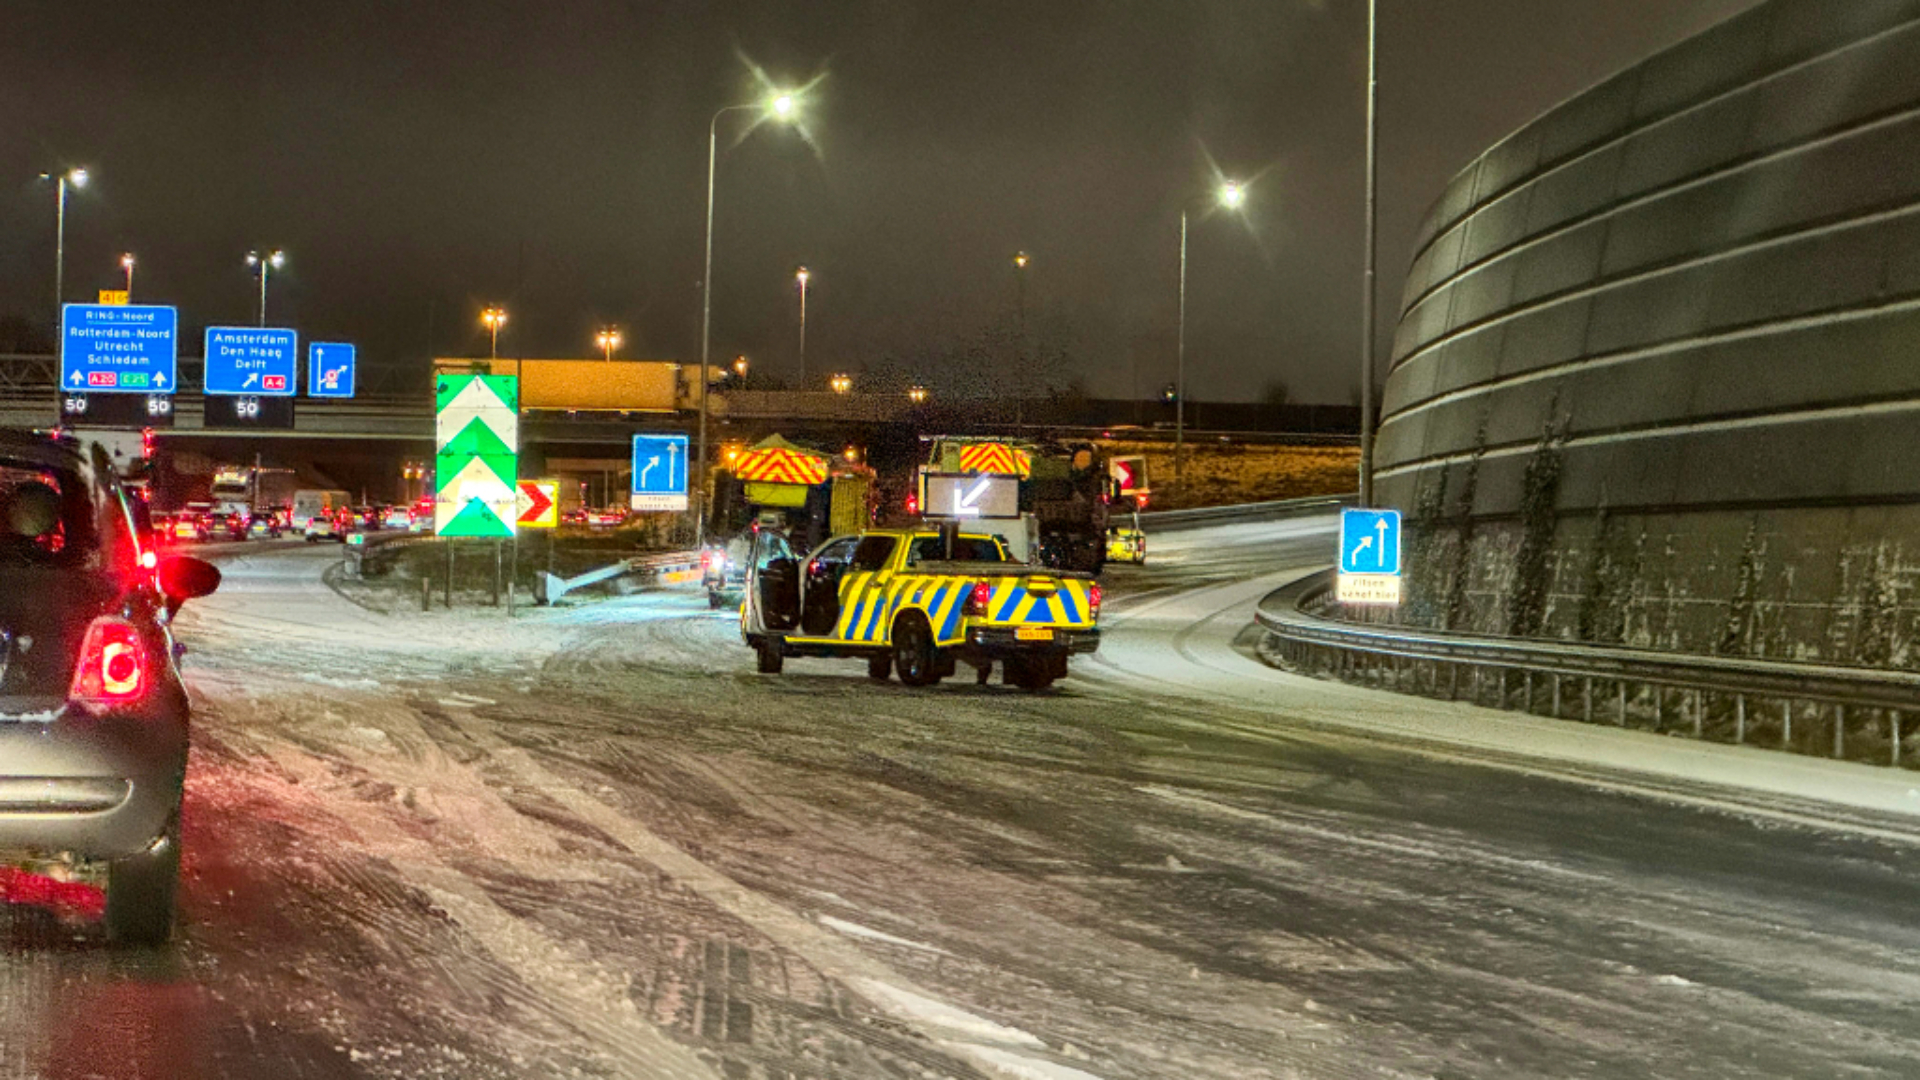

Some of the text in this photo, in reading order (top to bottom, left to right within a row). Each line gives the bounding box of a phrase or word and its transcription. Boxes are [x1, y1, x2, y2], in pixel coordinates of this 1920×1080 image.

[70, 327, 170, 338] Rotterdam-Noord
[214, 333, 288, 344] Amsterdam
[95, 341, 144, 351] Utrecht
[220, 346, 282, 359] Den Haag
[87, 354, 151, 365] Schiedam
[235, 359, 267, 369] Delft
[65, 399, 86, 412] 50
[148, 401, 170, 414] 50
[237, 402, 259, 415] 50
